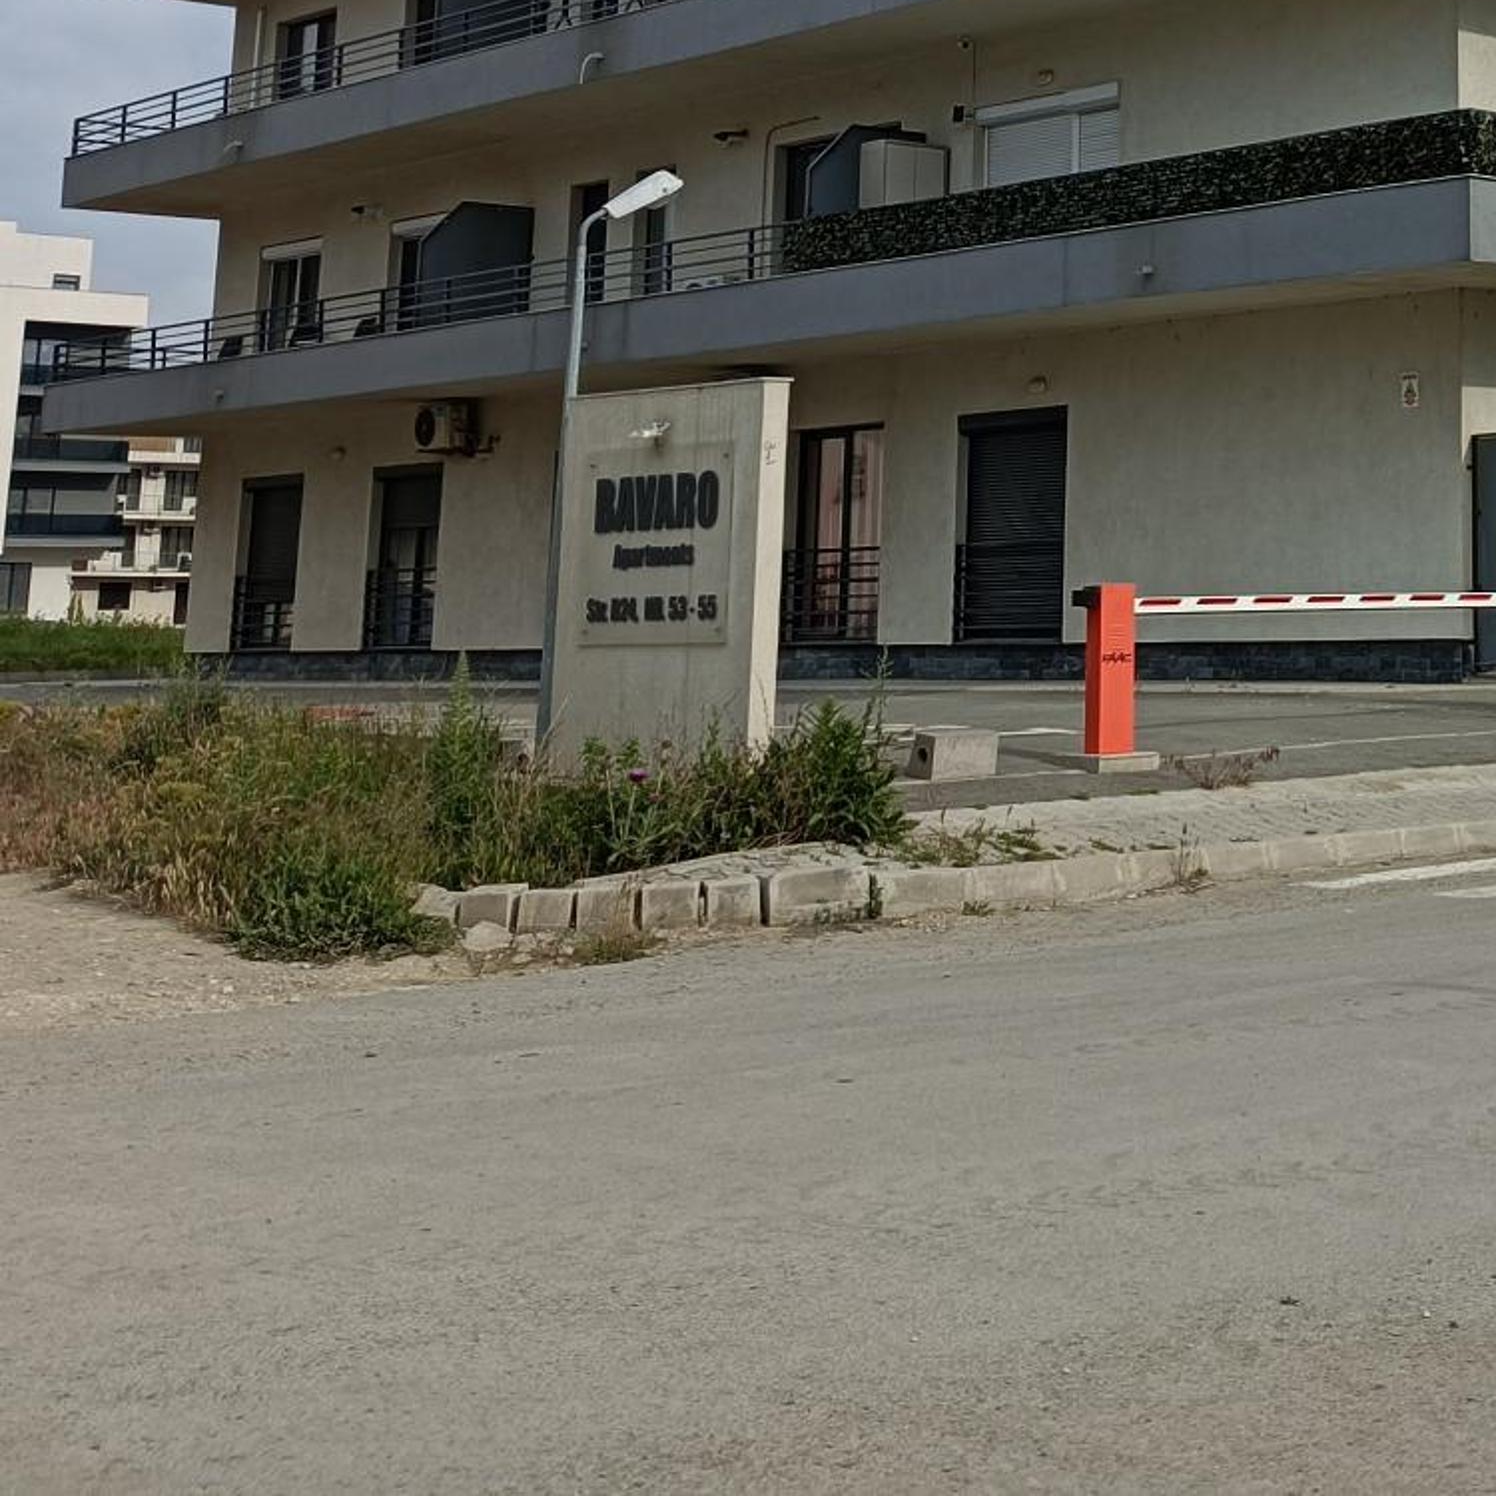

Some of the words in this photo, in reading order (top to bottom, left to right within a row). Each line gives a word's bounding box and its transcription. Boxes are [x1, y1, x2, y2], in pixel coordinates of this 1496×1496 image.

[595, 470, 719, 534] BAVARO
[612, 543, 695, 571] Apartments
[667, 595, 687, 621] 53
[698, 594, 717, 621] 55
